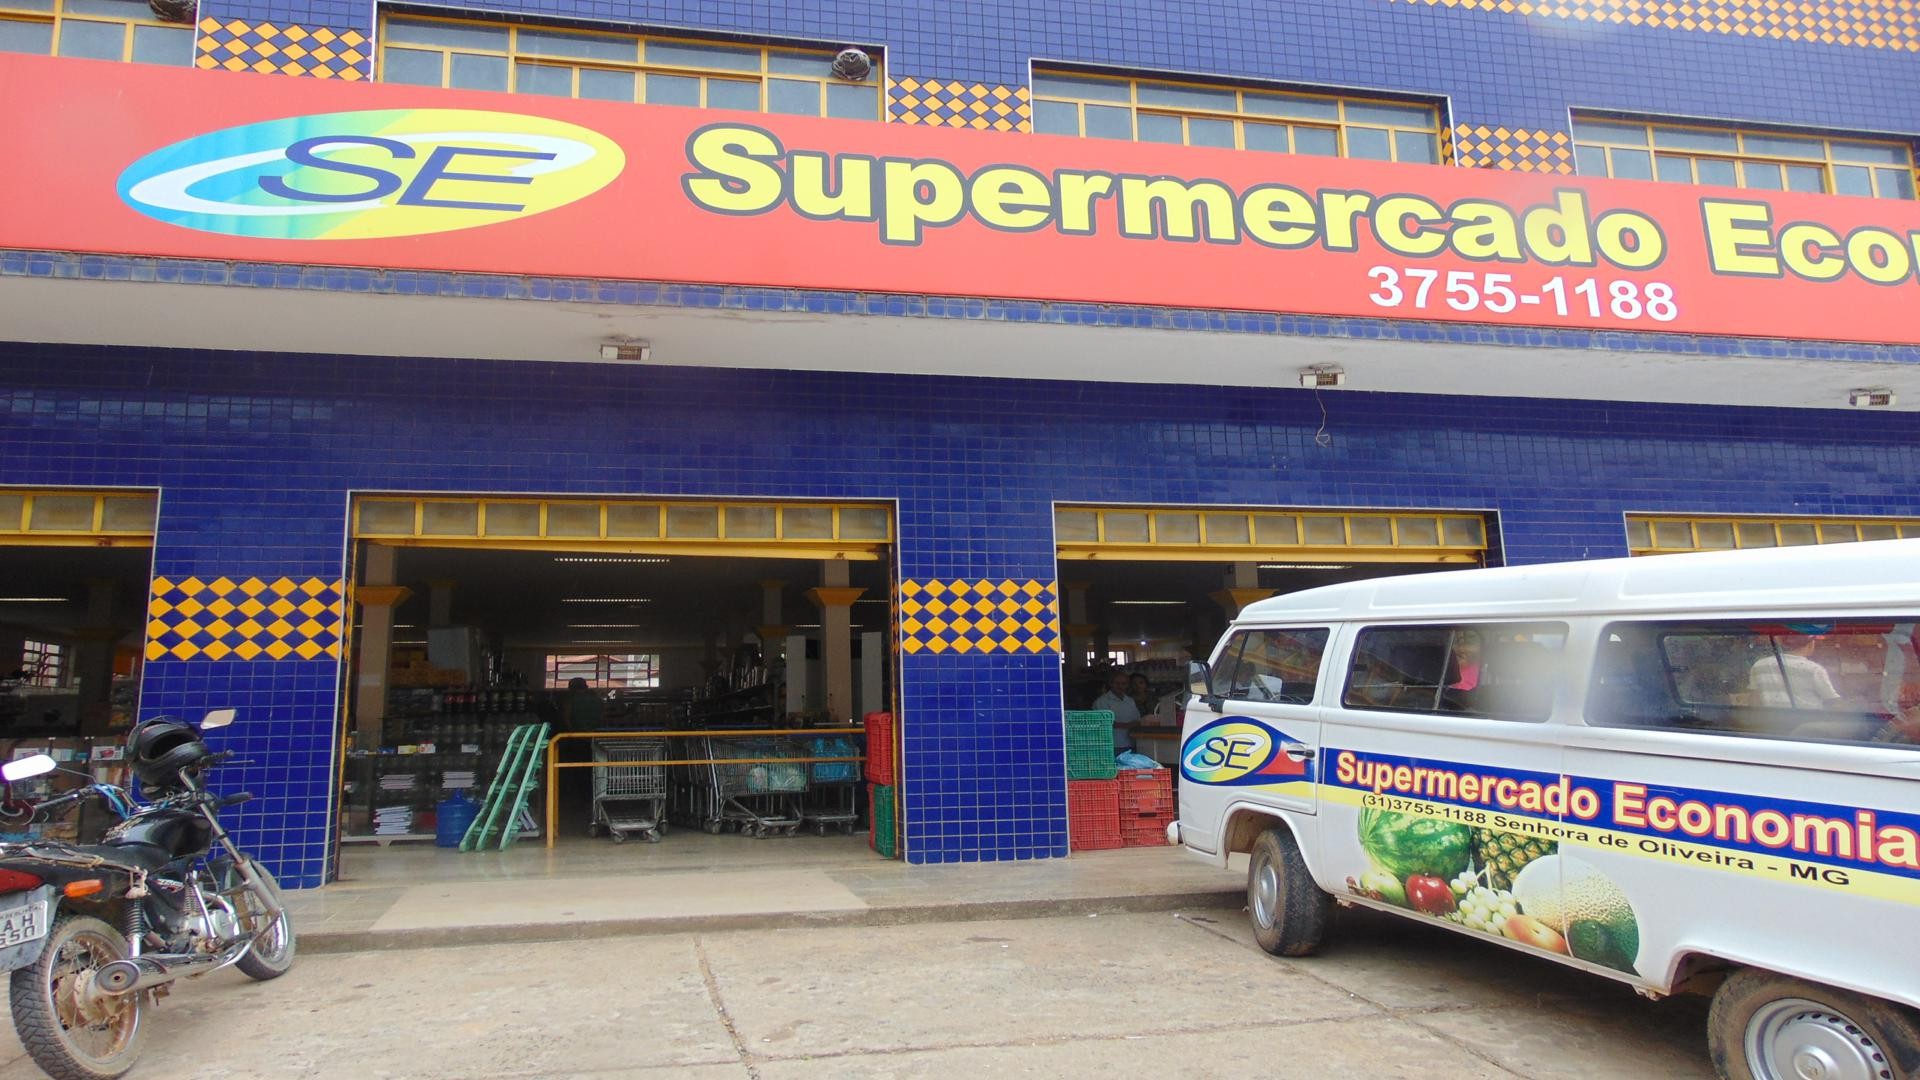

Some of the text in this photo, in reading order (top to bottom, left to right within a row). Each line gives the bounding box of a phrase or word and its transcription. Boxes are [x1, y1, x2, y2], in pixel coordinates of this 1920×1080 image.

[258, 135, 558, 212] SE
[681, 122, 1920, 286] Supermercado Eco
[1367, 264, 1679, 323] 3755-1188
[1201, 736, 1257, 770] SE
[1336, 750, 1920, 870] Supermercado Economia
[1362, 794, 1487, 824] (31)3755-1188
[1494, 815, 1590, 842] Senhora
[1598, 833, 1630, 848] de
[1638, 838, 1755, 871] Oliveira
[1790, 863, 1850, 886] MG
